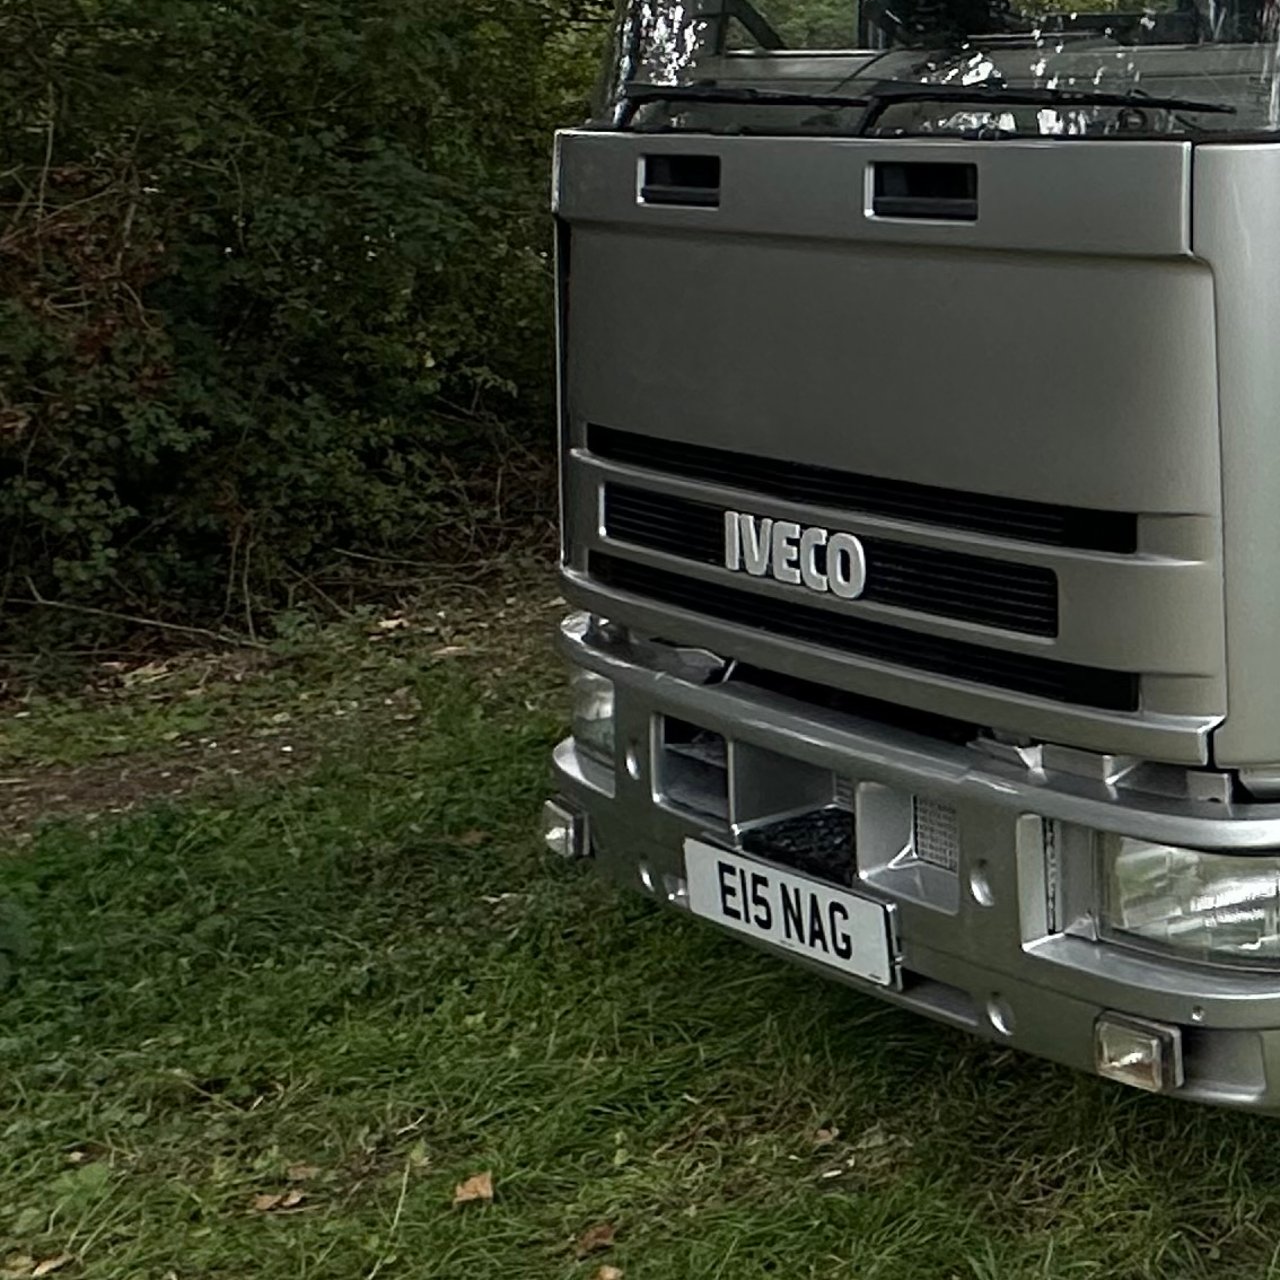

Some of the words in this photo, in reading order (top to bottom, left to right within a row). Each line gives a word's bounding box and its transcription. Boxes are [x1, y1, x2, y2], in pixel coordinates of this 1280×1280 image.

[724, 510, 867, 600] IVECO
[717, 860, 772, 930] E15
[780, 883, 853, 960] NAG
